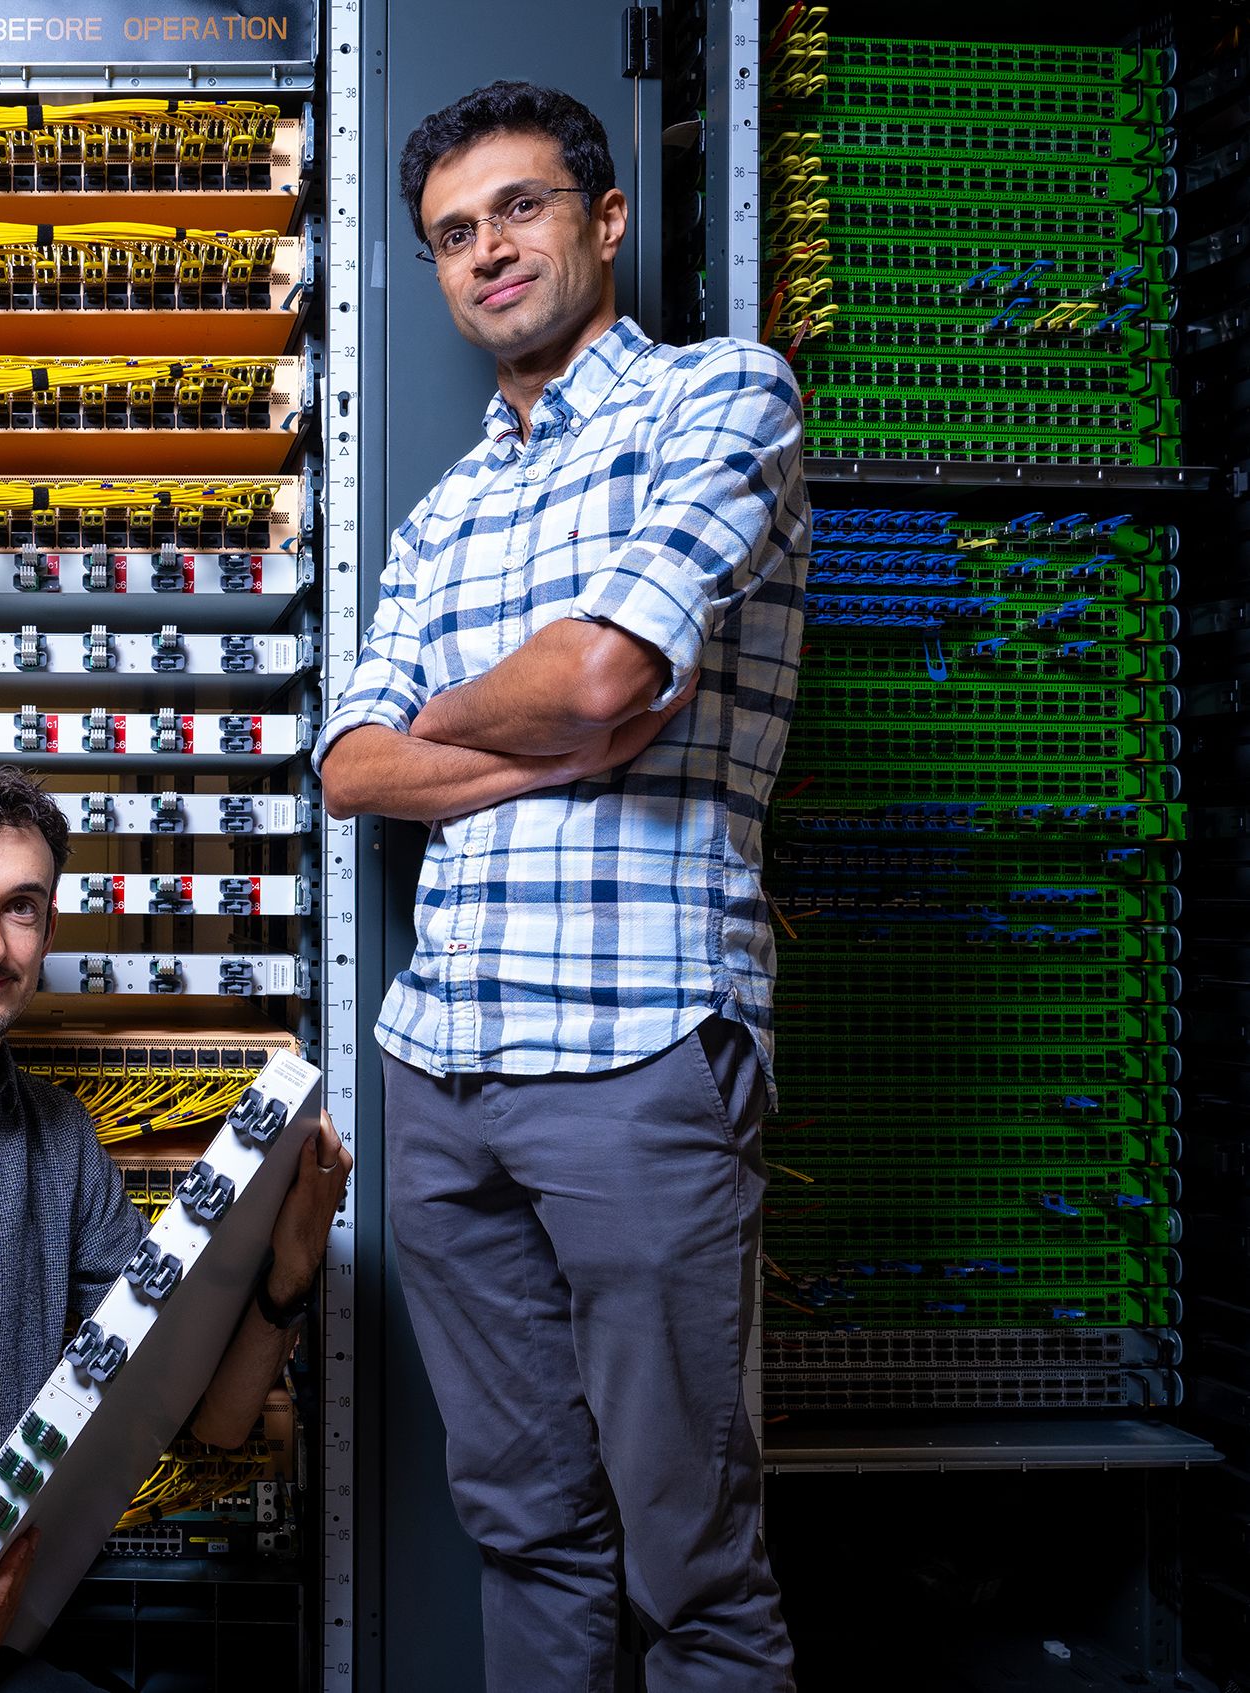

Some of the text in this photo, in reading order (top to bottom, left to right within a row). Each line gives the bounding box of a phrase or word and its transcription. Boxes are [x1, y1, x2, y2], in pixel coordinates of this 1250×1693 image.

[346, 2, 357, 11] 40
[124, 16, 287, 40] OPERATION
[735, 35, 745, 46] 39
[735, 79, 745, 90] 38
[346, 88, 357, 98] 38
[348, 130, 357, 141] 37
[734, 167, 744, 177] 36
[346, 174, 357, 184] 36
[734, 211, 744, 221] 35
[346, 217, 357, 227] 35
[345, 260, 356, 270] 34
[734, 255, 744, 265] 34
[734, 299, 744, 309] 33
[344, 347, 356, 357] 32
[344, 477, 355, 487] 29
[344, 520, 355, 530] 28
[48, 561, 58, 570] c1
[116, 561, 126, 570] c2
[183, 561, 194, 570] c3
[115, 581, 126, 589] c6
[184, 581, 194, 589] c7
[343, 607, 354, 617] 26
[343, 650, 354, 661] 25
[47, 721, 58, 729] c1
[115, 721, 126, 729] c2
[182, 721, 193, 730] c3
[115, 741, 126, 749] c6
[342, 826, 353, 835] 21
[342, 869, 353, 879] 20
[113, 881, 124, 889] c2
[182, 881, 192, 890] c3
[113, 901, 124, 910] c6
[342, 912, 353, 923] 19
[342, 1000, 353, 1010] 17
[342, 1044, 353, 1054] 16
[342, 1088, 353, 1098] 15
[341, 1132, 352, 1142] 14
[341, 1264, 352, 1275] 11
[340, 1308, 351, 1319] 10
[339, 1397, 350, 1407] 08
[339, 1441, 350, 1451] 07
[339, 1485, 350, 1496] 06
[339, 1530, 350, 1540] 05
[338, 1574, 350, 1584] 04
[338, 1663, 350, 1673] 02
